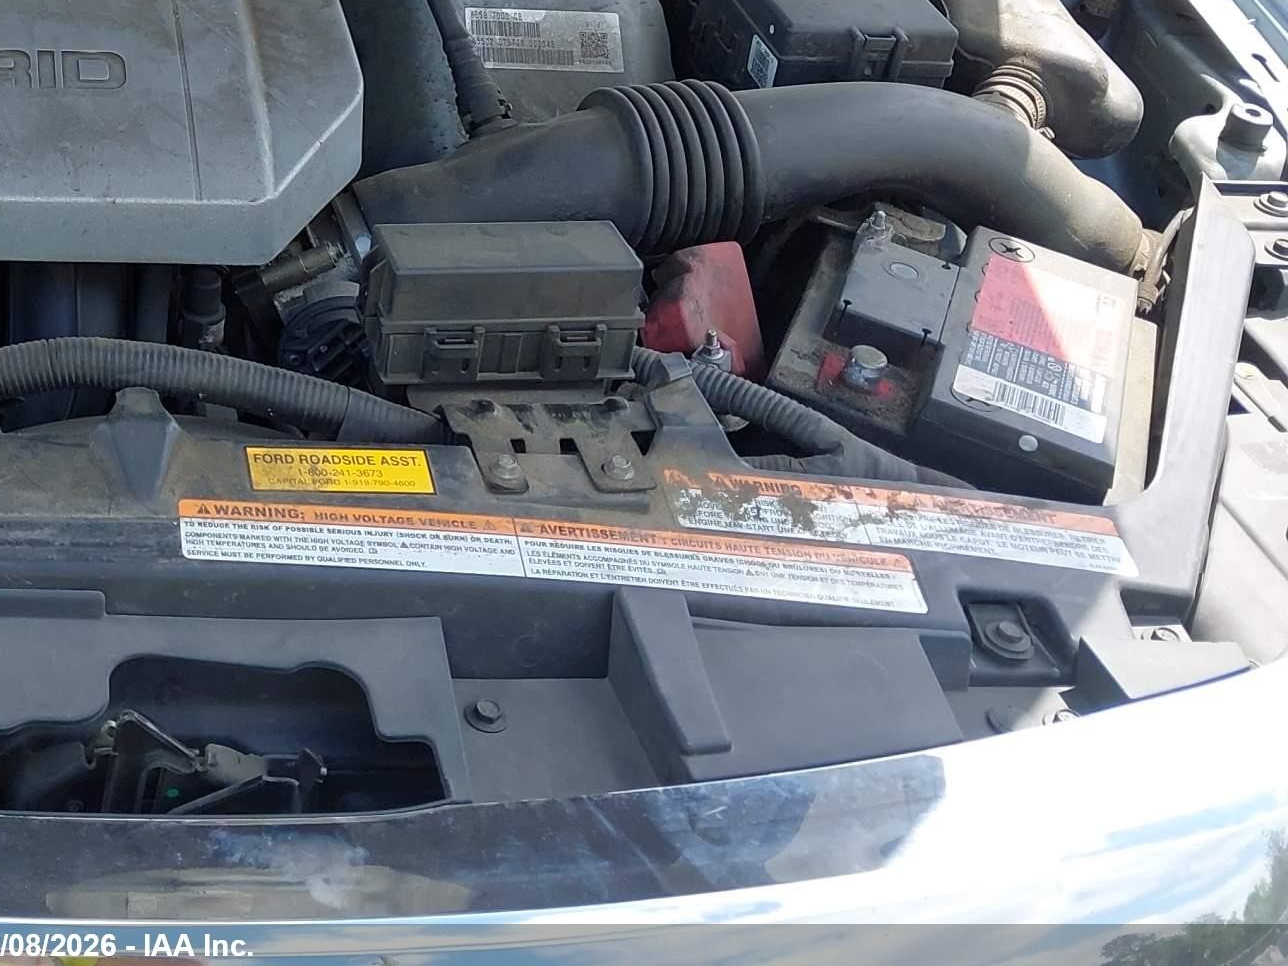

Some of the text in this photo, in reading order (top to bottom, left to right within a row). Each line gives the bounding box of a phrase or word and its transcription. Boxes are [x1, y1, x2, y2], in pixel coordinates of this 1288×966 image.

[253, 453, 422, 467] FORD ROADSIDE ASST.
[268, 477, 308, 486] CAPITAL
[298, 467, 384, 478] 1-800-241-3673
[214, 504, 479, 530] WARNING: HIGH VOLTAGE VEHICLE
[184, 520, 195, 528] TO
[198, 521, 230, 529] REDUCE
[251, 523, 270, 531] RISK
[272, 524, 283, 532] OF
[285, 525, 325, 534] POSSIBLE
[327, 528, 362, 536] SERIOUS
[364, 530, 394, 538] INJURY
[396, 531, 428, 540] (SHOCK
[430, 533, 441, 541] OR
[470, 535, 482, 543] OR
[185, 531, 238, 540] COMPONENTS
[240, 534, 271, 542] MARKED
[274, 535, 293, 543] WITH
[311, 537, 329, 545] HIGH
[331, 538, 365, 548] VOLTAGE
[367, 540, 399, 548] SYMBOL
[409, 542, 443, 551] CONTAIN
[444, 544, 463, 552] HIGH
[464, 545, 498, 554] VOLTAGE
[500, 547, 516, 556] AND
[207, 540, 267, 549] TEMPERATURES
[286, 543, 317, 552] SHOULD
[539, 523, 657, 545] AVERTISSEMENT
[671, 537, 721, 551] CIRCUITS
[723, 542, 762, 554] HAUTE
[763, 545, 813, 560] TENSION
[186, 549, 219, 557] SERVICE
[256, 552, 304, 562] PERFORMED
[305, 554, 315, 562] BY
[317, 555, 357, 565] QUALIFIED
[359, 558, 404, 567] PERSONNEL
[524, 539, 547, 548] POUR
[587, 544, 602, 553] LES
[604, 546, 639, 556] RISQUES
[641, 548, 652, 557] DE
[654, 550, 701, 562] BLESSURES
[703, 553, 735, 564] GRAVES
[526, 550, 543, 558] LES
[639, 558, 650, 566] DU
[652, 559, 686, 570] SYMBOLE
[687, 562, 712, 572] HAUTE
[713, 565, 745, 576] TENSION
[563, 559, 573, 567] ET
[574, 561, 606, 571] DOIVENT
[531, 568, 540, 576] LA
[542, 568, 589, 580] RÉPARATION
[590, 572, 600, 580] ET
[648, 577, 680, 587] DOIVENT
